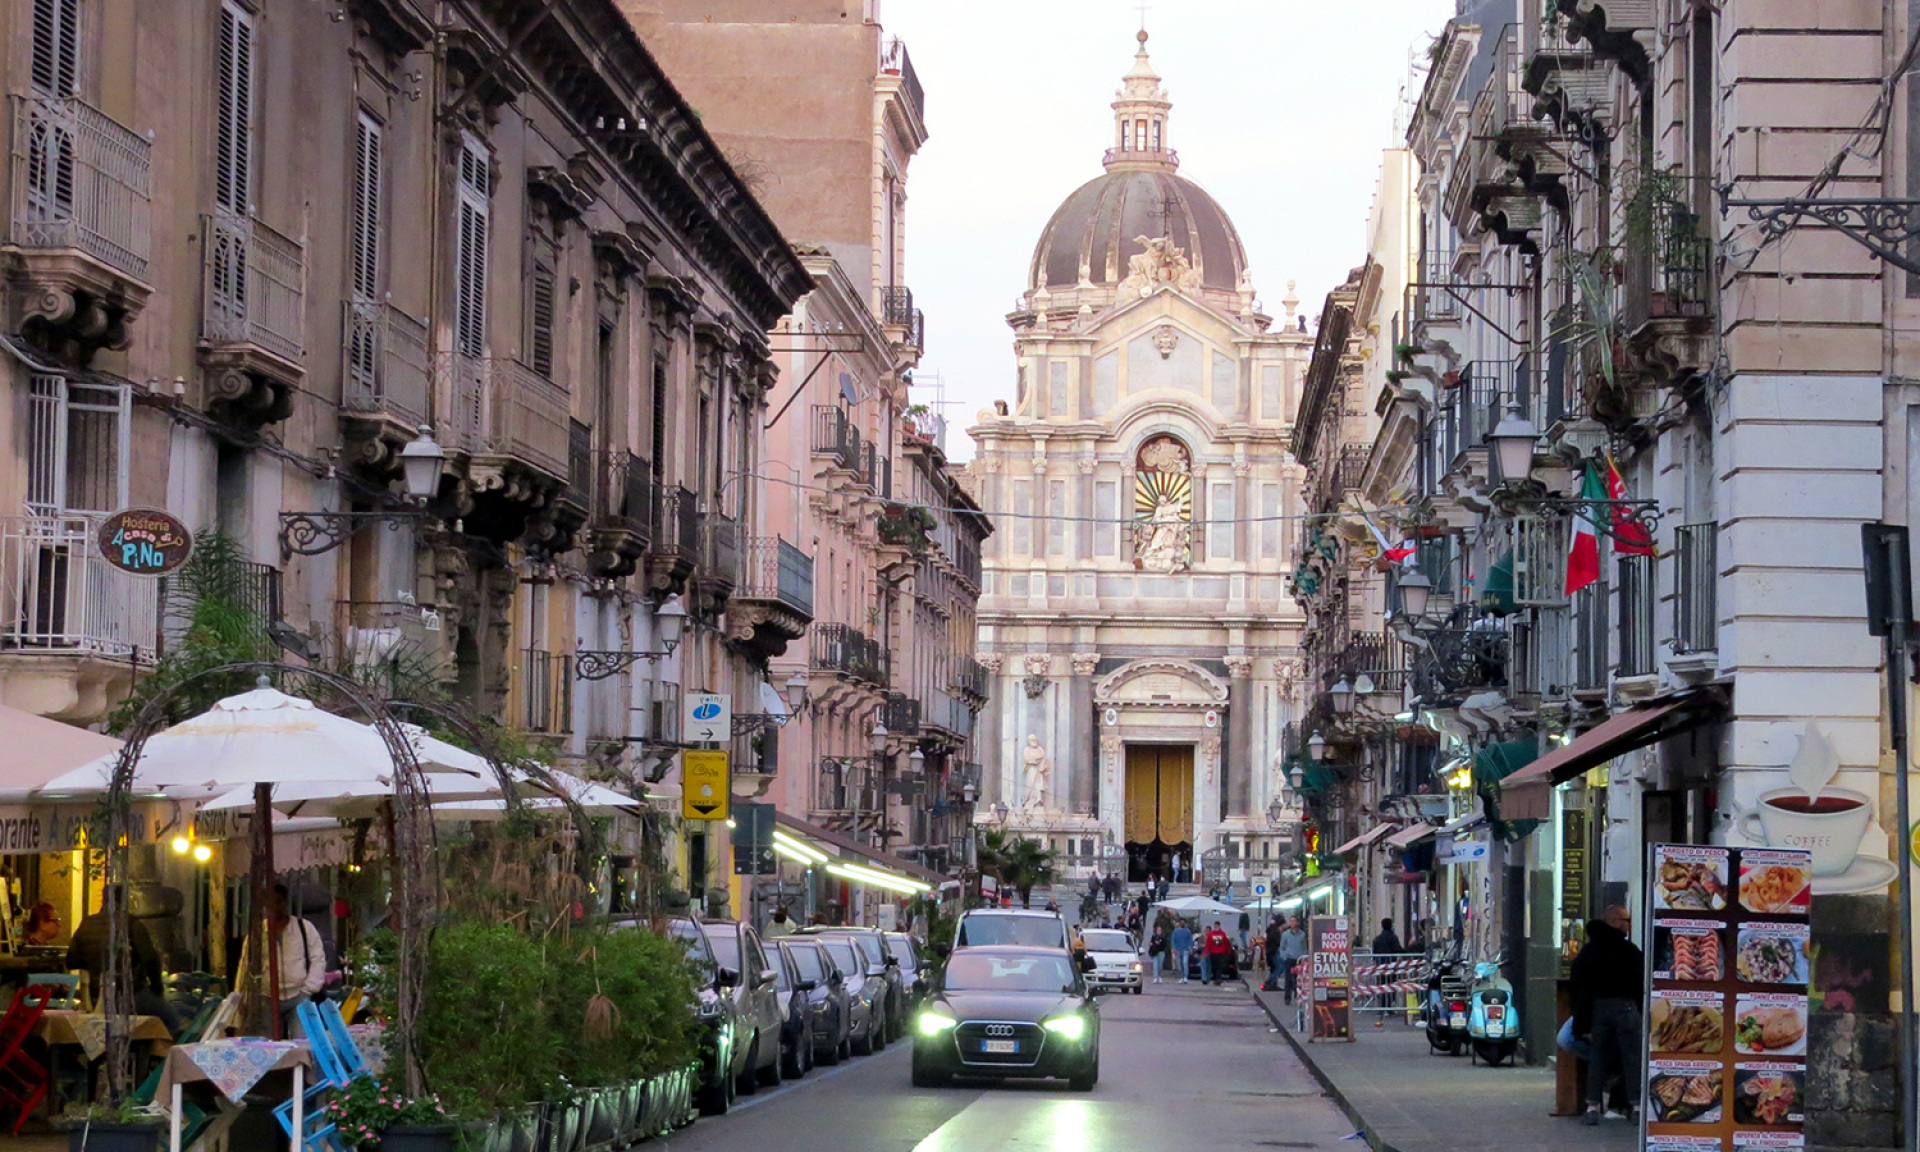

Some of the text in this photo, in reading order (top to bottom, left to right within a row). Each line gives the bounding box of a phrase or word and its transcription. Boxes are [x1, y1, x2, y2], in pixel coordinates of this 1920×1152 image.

[121, 516, 170, 532] Hosteria
[1783, 834, 1832, 848] COFFEE
[1321, 932, 1348, 940] BOOK
[1321, 940, 1348, 949] NOW
[1313, 951, 1348, 963] ETNA
[1313, 963, 1349, 974] DAILY
